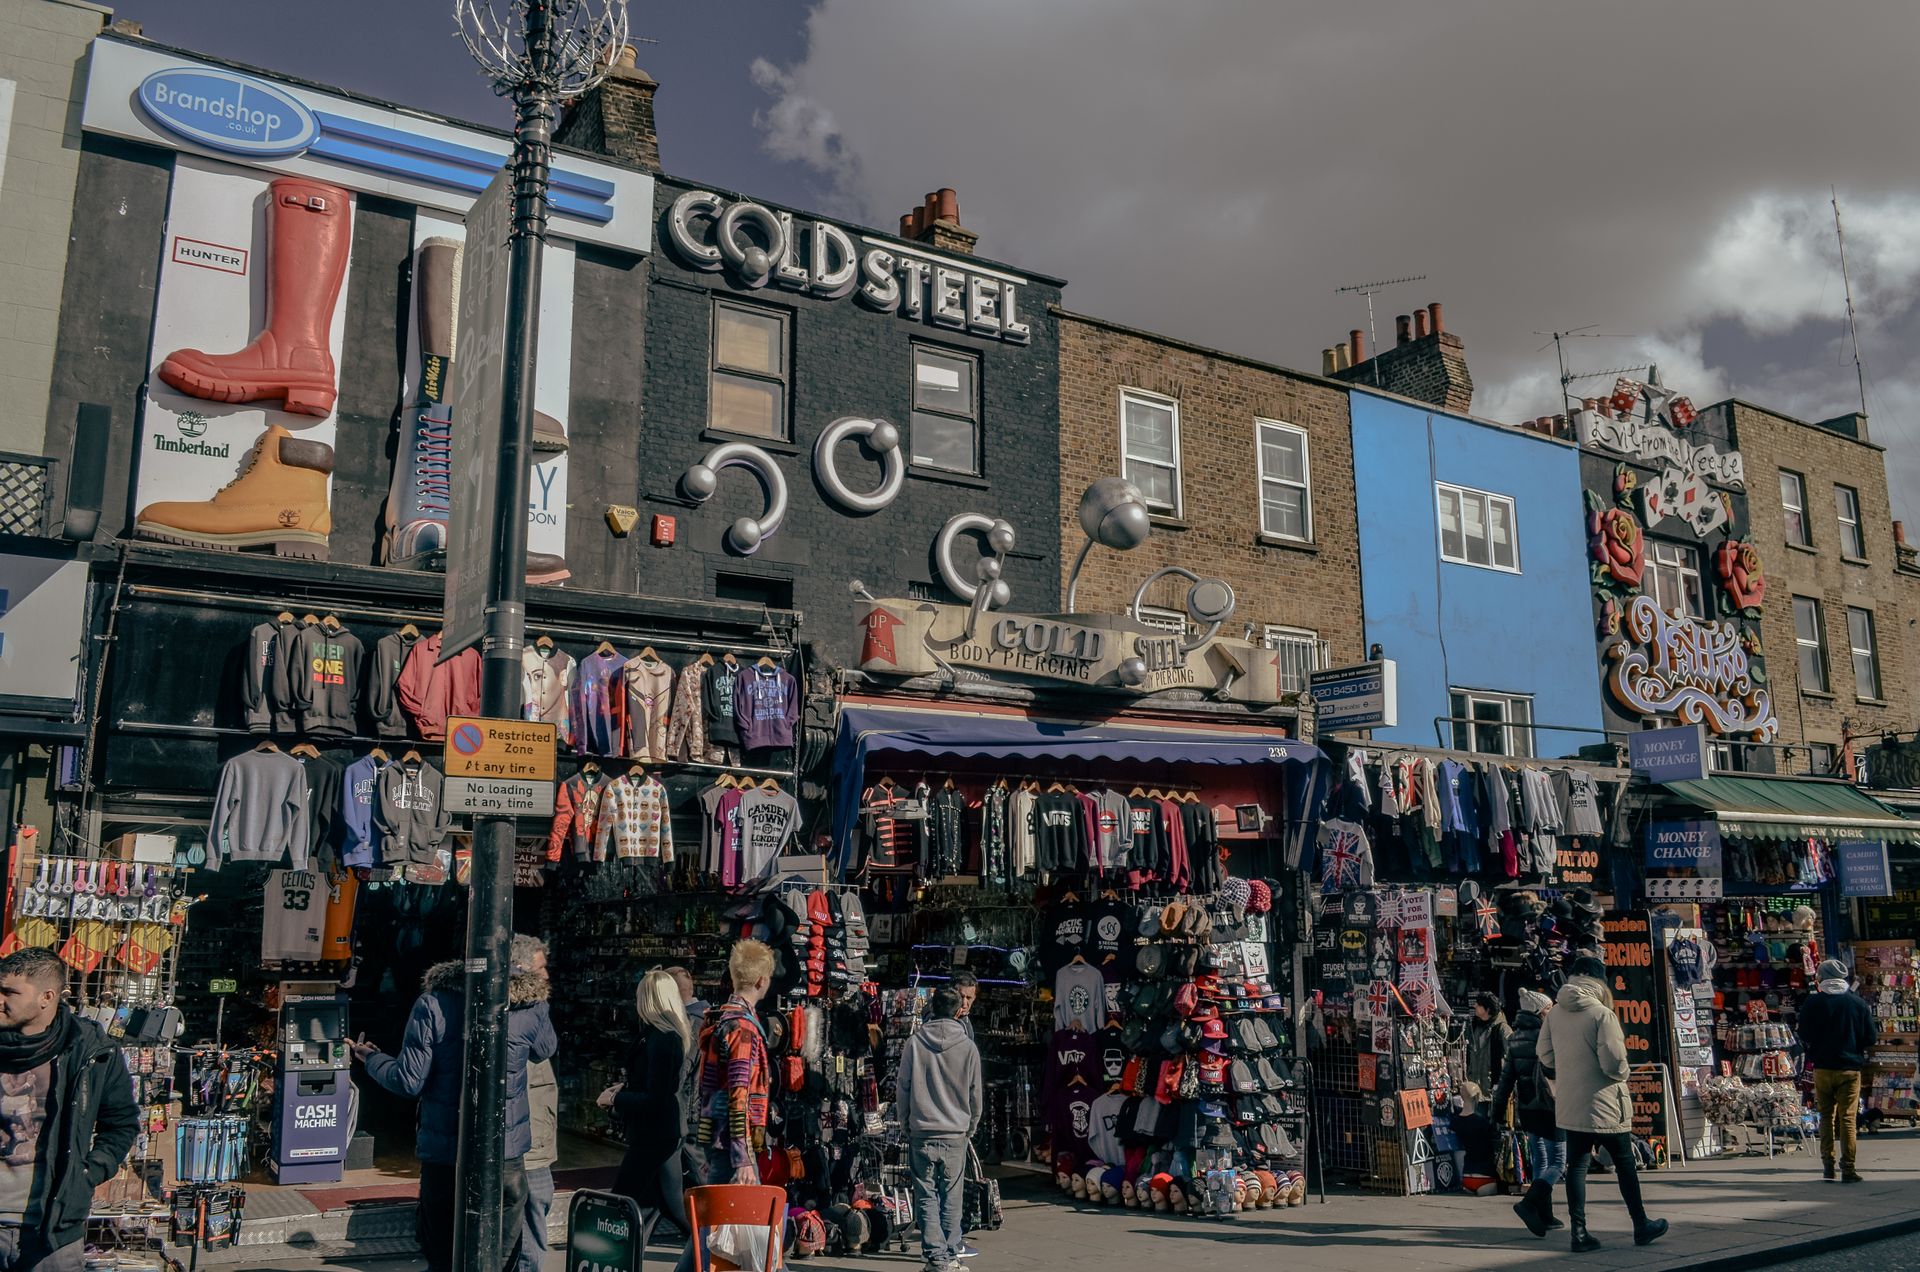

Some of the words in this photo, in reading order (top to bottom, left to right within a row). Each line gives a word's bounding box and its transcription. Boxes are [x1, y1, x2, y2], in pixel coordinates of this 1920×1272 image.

[154, 82, 281, 143] Brandshop
[225, 121, 257, 135] .co.uk
[180, 246, 241, 266] HUNTER
[667, 190, 858, 290] COLD
[862, 248, 1031, 341] STEEL
[424, 355, 440, 401] AirWair
[153, 433, 230, 458] Timberland
[1591, 410, 1640, 449] Evil
[1641, 434, 1667, 453] from
[1684, 444, 1740, 479] Neele
[869, 614, 887, 629] UP
[997, 618, 1105, 662] COLD
[1630, 596, 1752, 699] Tattoo
[950, 642, 997, 664] BODY
[1003, 651, 1090, 681] PIERCING
[1155, 668, 1194, 685] PIERCING
[1313, 687, 1331, 698] 020
[1332, 684, 1357, 696] 8450
[1358, 680, 1380, 691] 1000
[488, 728, 551, 743] Restricted
[504, 743, 534, 755] Zone
[1268, 747, 1288, 758] 238
[1643, 739, 1686, 754] MONEY
[1633, 752, 1698, 769] EXCHANGE
[484, 763, 505, 775] any
[509, 763, 536, 774] time
[467, 782, 484, 794] No
[489, 783, 533, 798] loading
[464, 796, 478, 807] at
[481, 799, 502, 809] any
[507, 798, 534, 808] time
[748, 804, 789, 821] CAMDEN
[752, 813, 785, 827] TOWN
[1130, 811, 1151, 822] RUN
[1656, 831, 1707, 844] MONEY
[1800, 826, 1827, 836] NEW
[1830, 827, 1864, 838] YORK
[513, 853, 538, 863] CALM
[1556, 850, 1599, 869] TATTOO
[1652, 846, 1712, 859] CHANGE
[1846, 850, 1878, 859] CAMBIO
[513, 868, 538, 876] ARRY
[1562, 870, 1593, 883] Studio
[281, 871, 316, 890] CELTICS
[1855, 884, 1884, 892] CHANGE
[282, 889, 310, 911] 33
[1403, 896, 1425, 905] VOTE
[1407, 906, 1423, 914] FOR
[1058, 918, 1083, 931] ARCTIC
[1403, 914, 1428, 924] PEDRO
[1055, 926, 1084, 936] MONKEYS
[1600, 942, 1652, 967] ERCING
[1614, 975, 1627, 991] &
[1612, 999, 1652, 1025] TTOO
[1624, 1034, 1650, 1052] dio
[295, 1104, 337, 1119] CASH
[294, 1117, 337, 1129] MACHINE
[596, 1217, 629, 1238] Infocash
